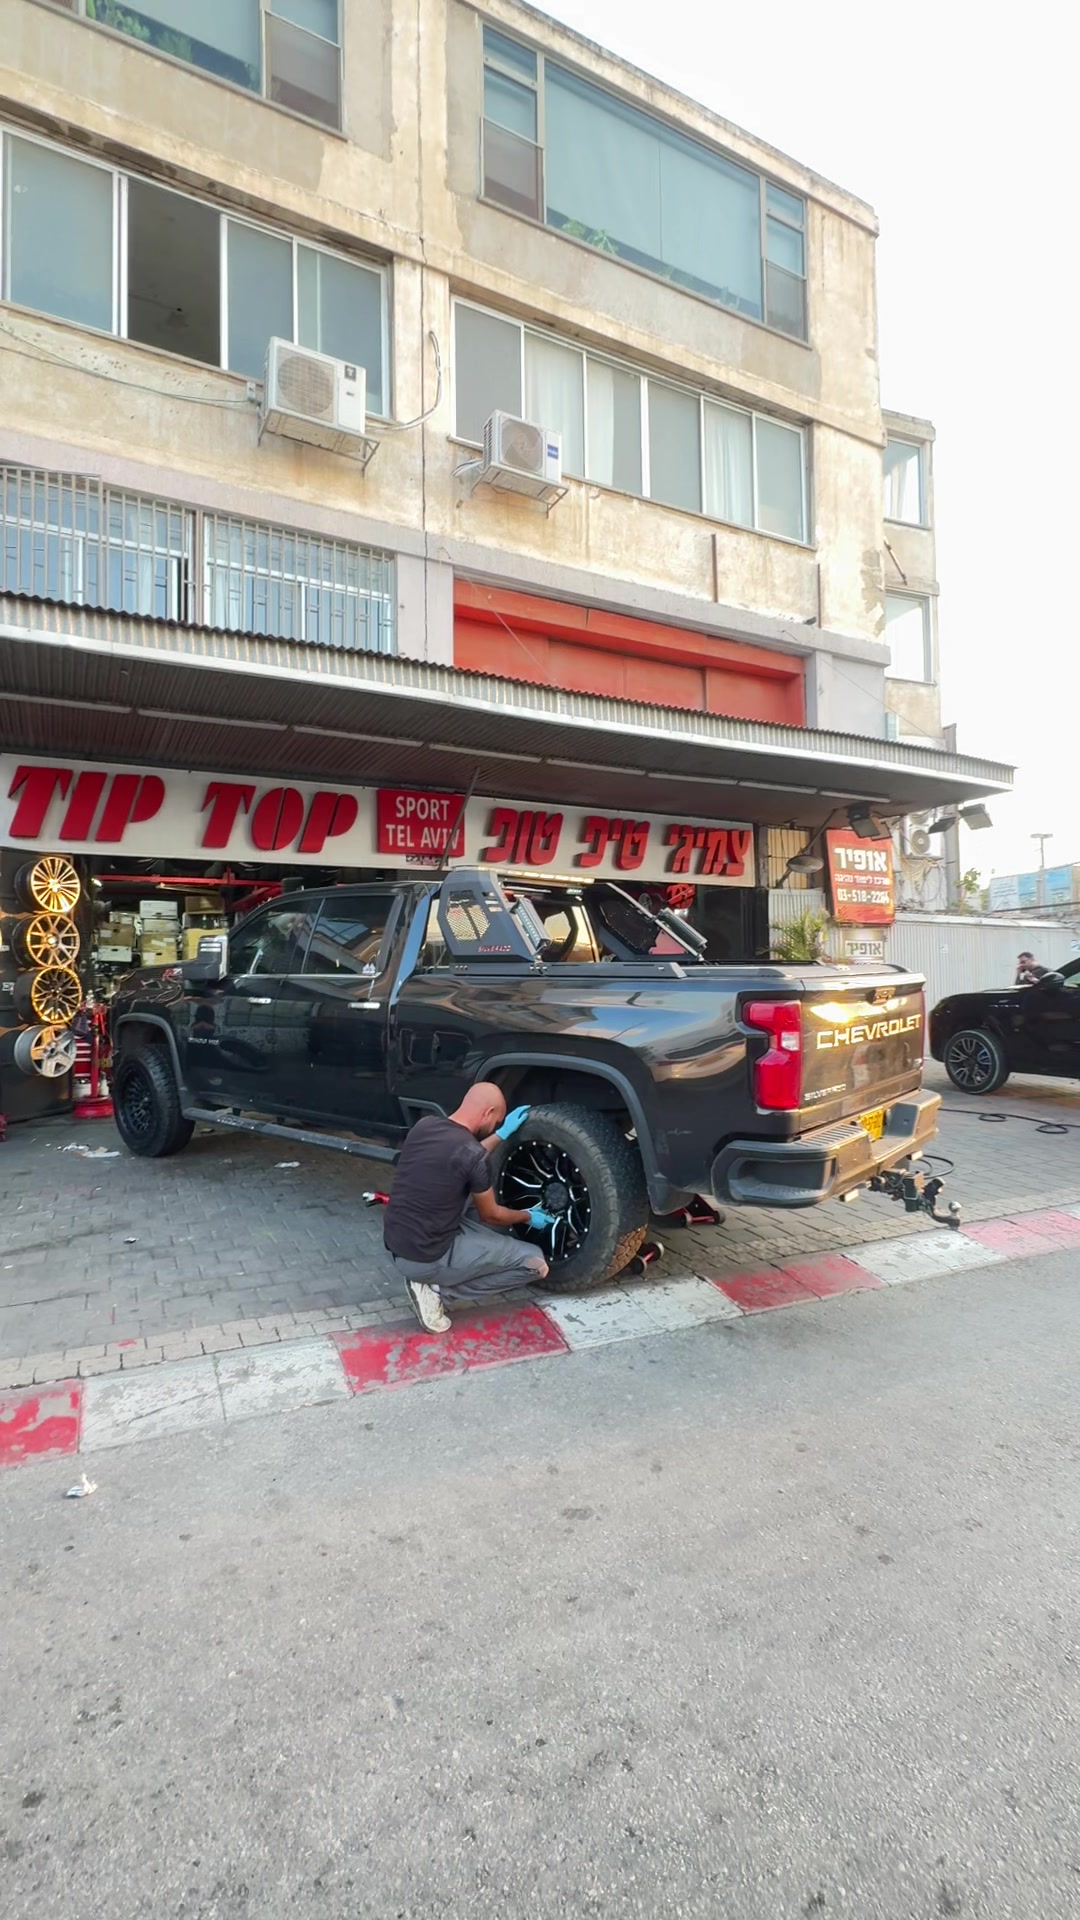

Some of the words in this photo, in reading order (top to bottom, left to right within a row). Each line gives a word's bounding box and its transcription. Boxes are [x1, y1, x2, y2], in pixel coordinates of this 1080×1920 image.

[8, 765, 166, 842] TIP
[201, 782, 359, 853] TOP
[396, 796, 450, 821] SPORT
[386, 824, 415, 847] TEL
[420, 827, 460, 849] AVIV
[484, 807, 564, 866] טופ
[580, 816, 650, 870] טיפ
[669, 824, 752, 876] צמיגי
[834, 847, 887, 872] אופיר
[816, 1014, 921, 1049] CHEVROLET
